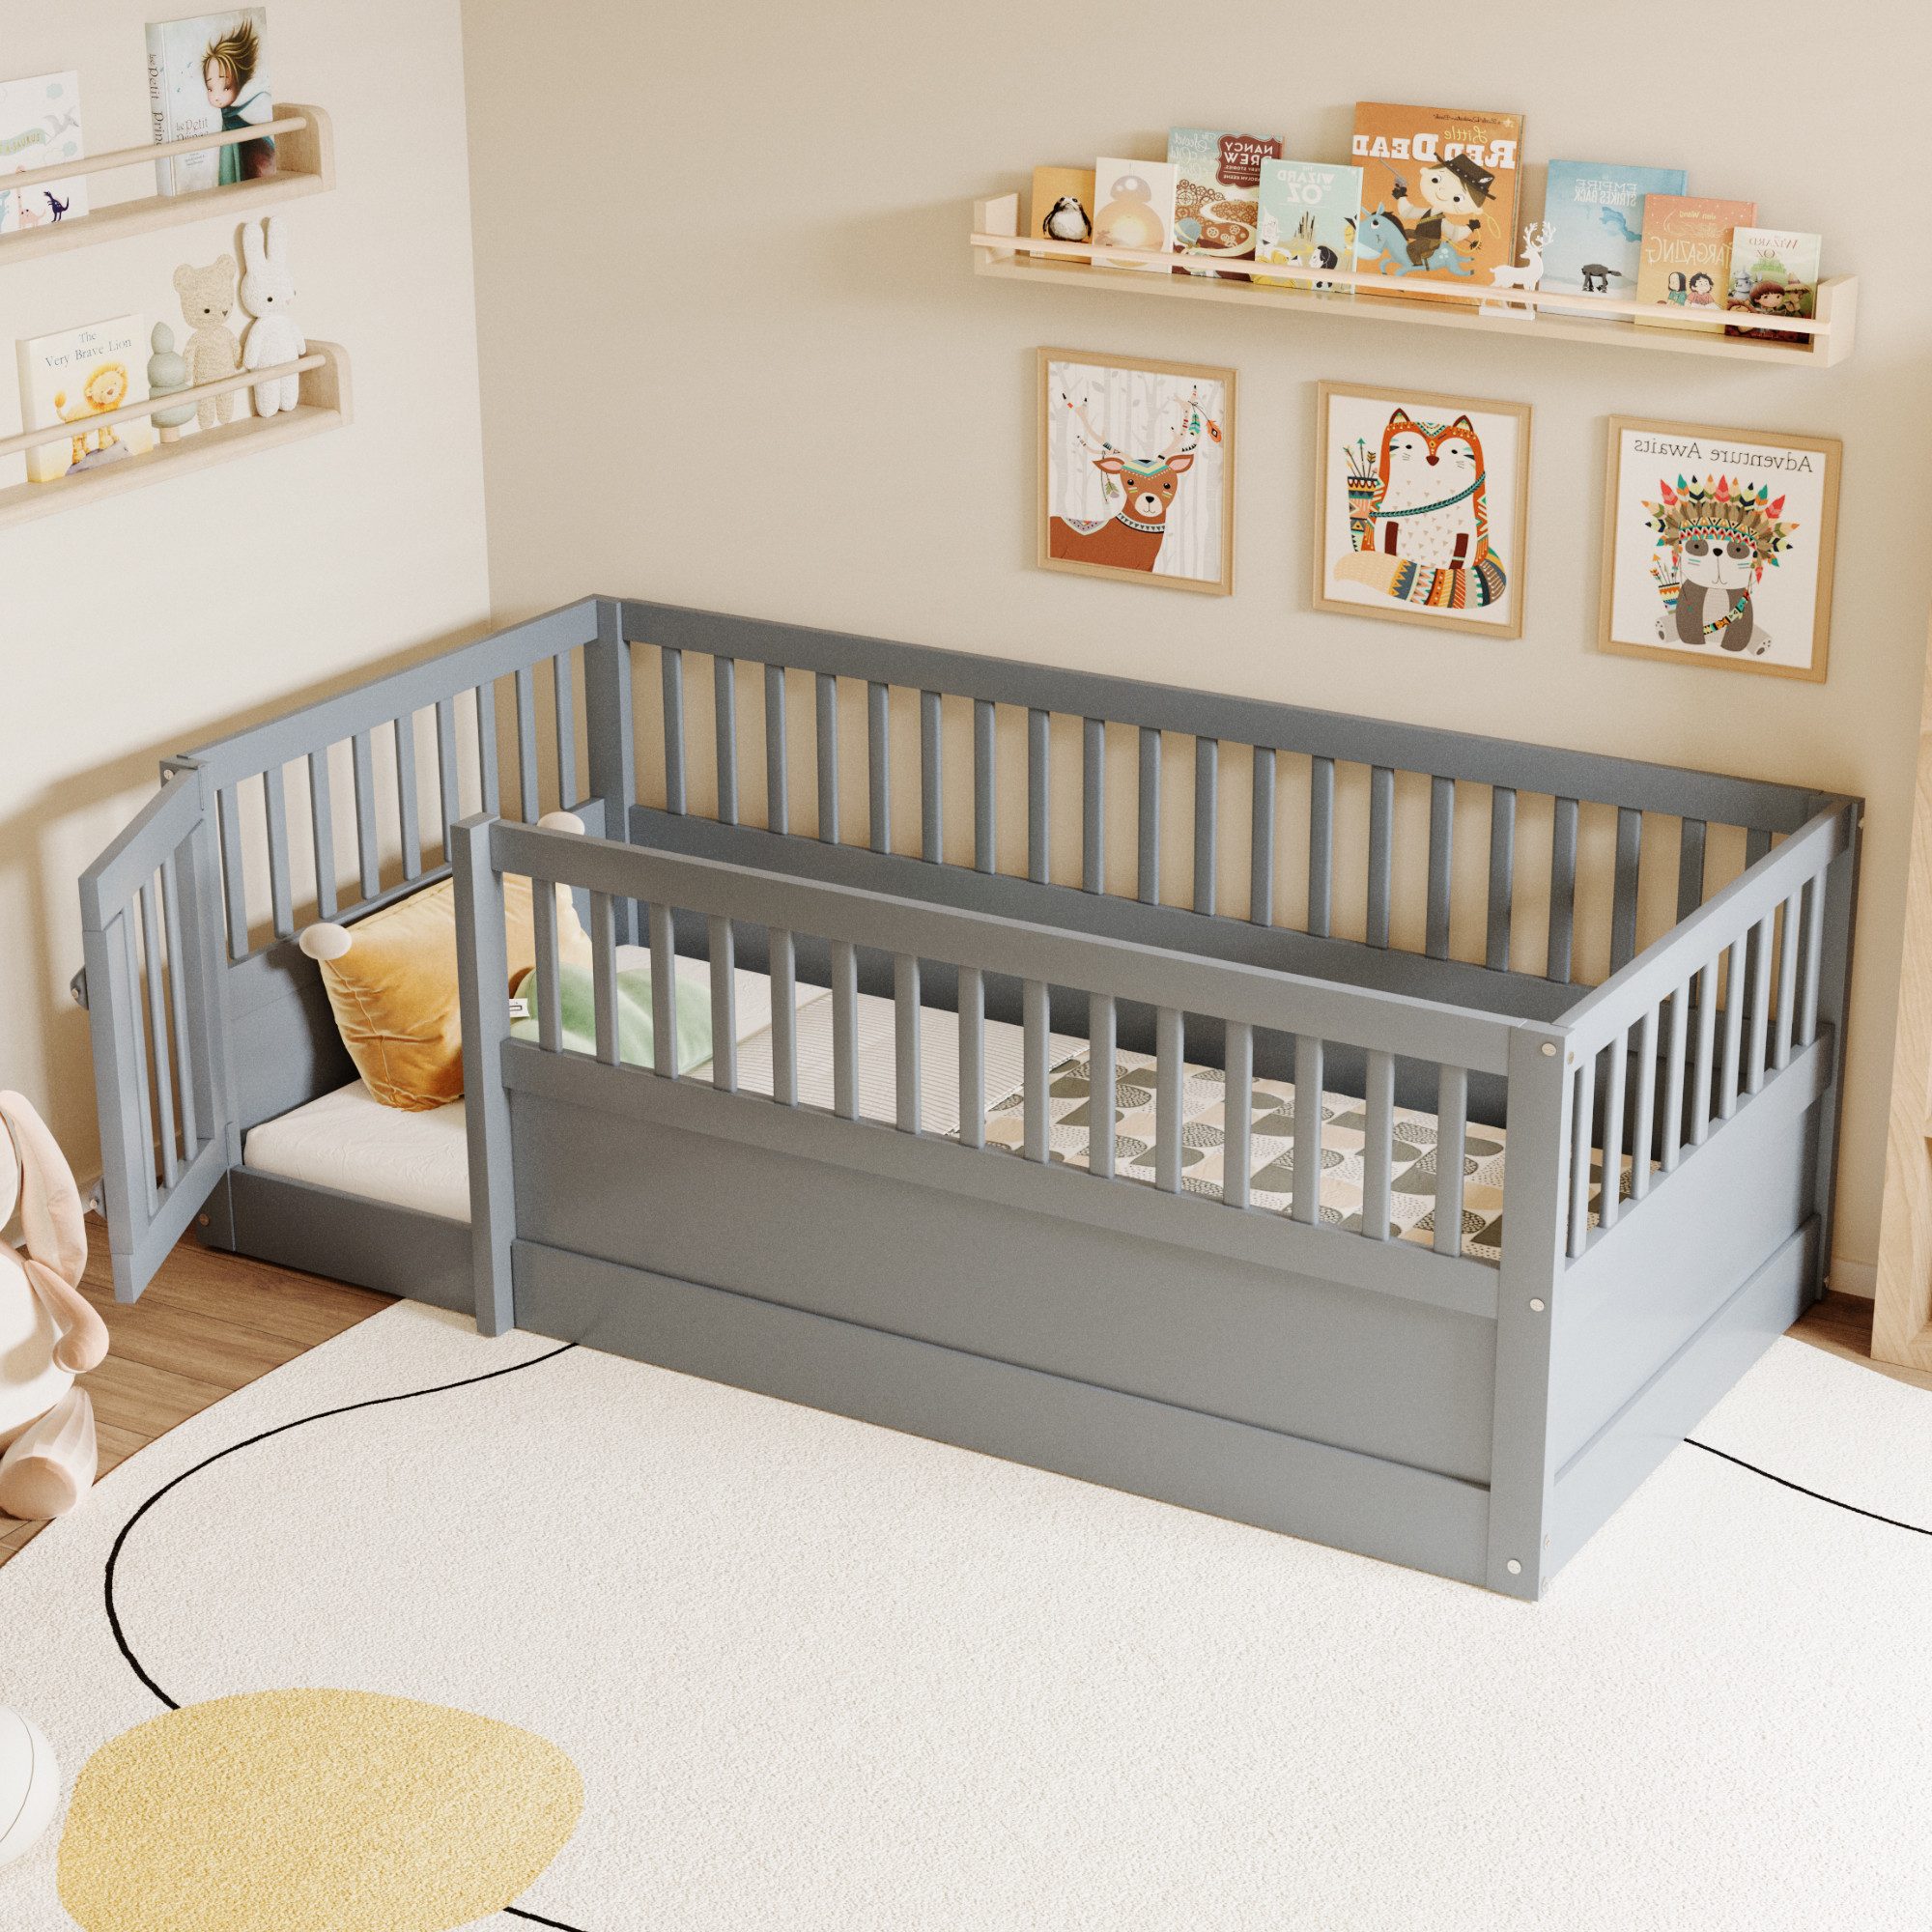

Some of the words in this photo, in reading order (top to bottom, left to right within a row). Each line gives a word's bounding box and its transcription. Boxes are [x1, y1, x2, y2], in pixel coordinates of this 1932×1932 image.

[148, 68, 159, 99] Petit
[185, 117, 209, 131] Petit
[78, 332, 97, 343] The
[44, 355, 70, 368] Very
[74, 347, 104, 360] Brave
[108, 339, 132, 352] Lion
